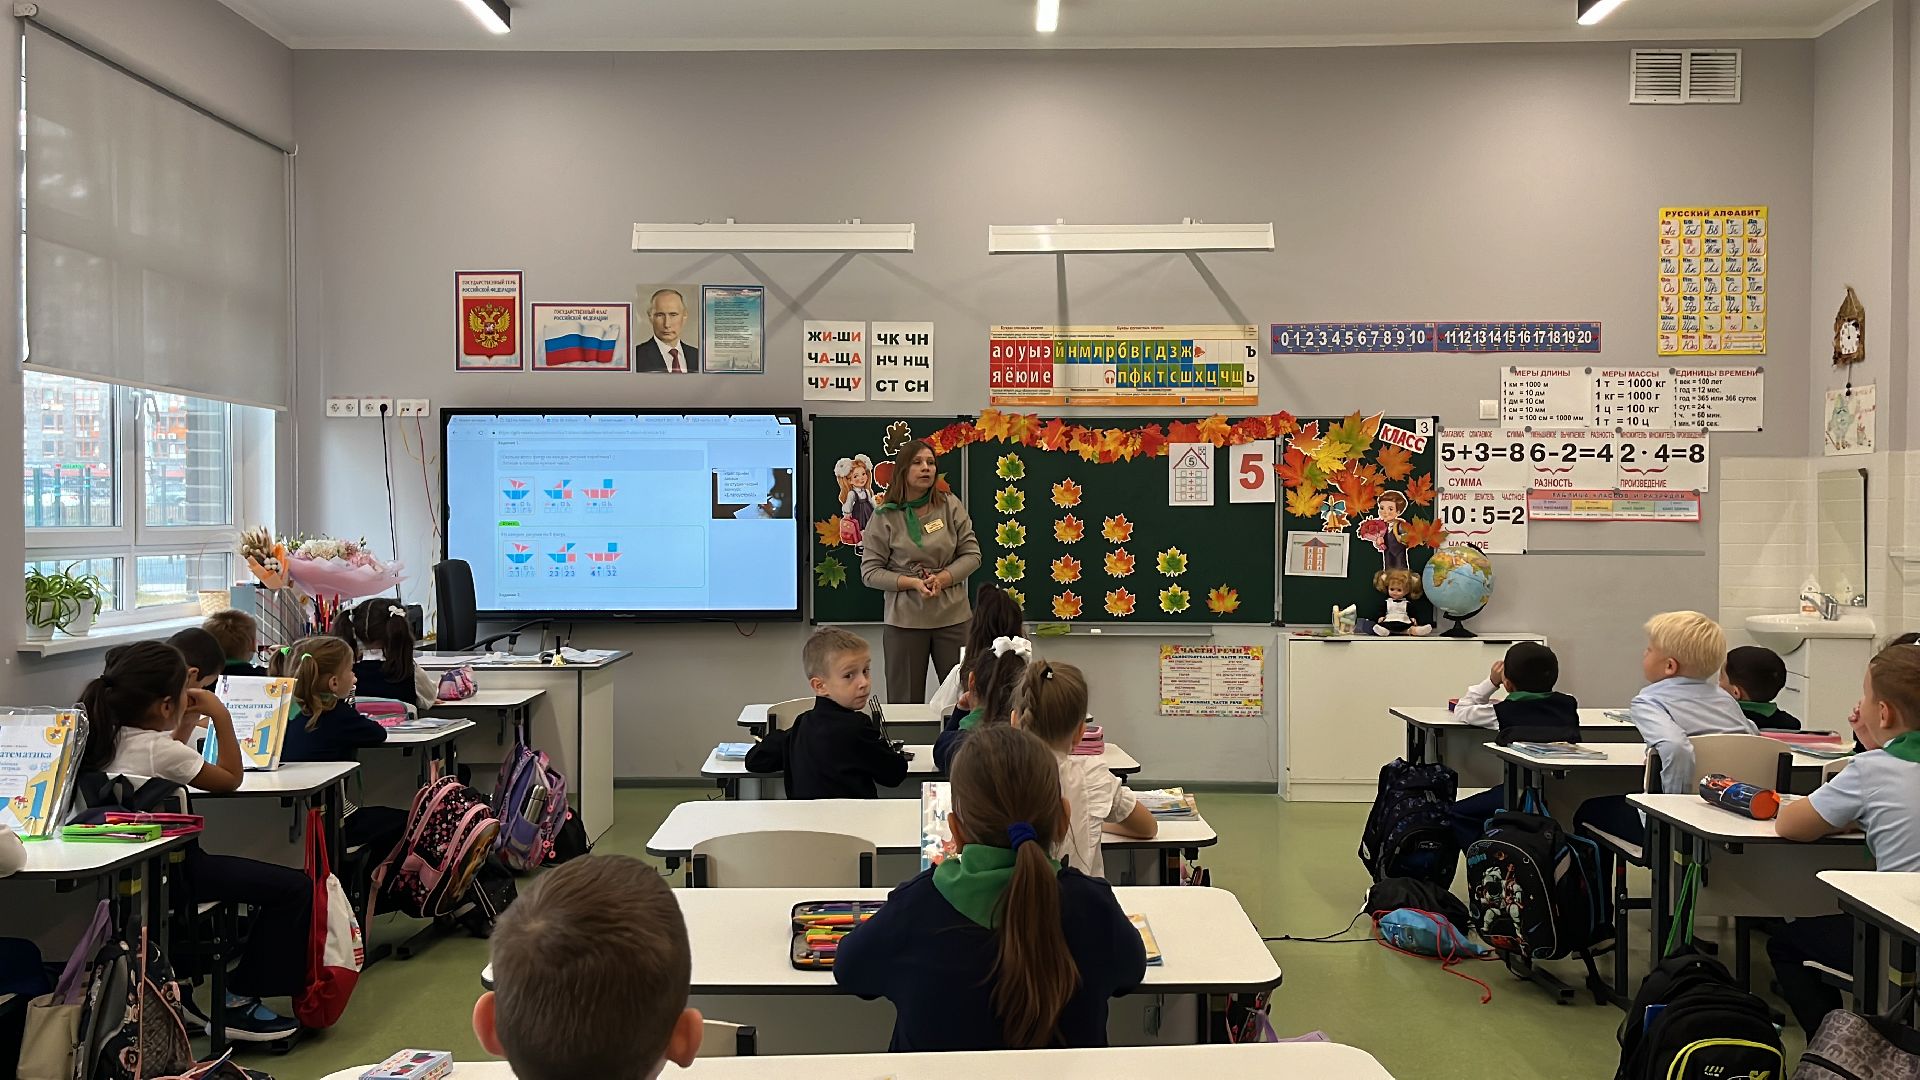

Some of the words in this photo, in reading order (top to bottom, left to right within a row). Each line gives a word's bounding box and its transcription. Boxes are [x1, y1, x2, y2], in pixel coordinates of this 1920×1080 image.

[808, 331, 861, 342] ЖИ-ШИ
[877, 334, 899, 345] ЧК
[906, 334, 928, 345] ЧН
[1281, 332, 1289, 346] 0
[1294, 332, 1300, 345] 1
[1306, 332, 1314, 345] 2
[1319, 332, 1327, 345] 3
[1332, 331, 1340, 345] 4
[1345, 331, 1353, 345] 5
[1358, 331, 1366, 344] 6
[1371, 331, 1378, 344] 7
[1383, 331, 1391, 344] 8
[1396, 331, 1405, 344] 9
[1409, 330, 1425, 344] 10
[1445, 331, 1456, 343] 11
[1458, 331, 1471, 343] 12
[1473, 331, 1486, 343] 13
[1488, 331, 1501, 343] 14
[1503, 331, 1516, 343] 15
[1518, 331, 1530, 343] 16
[1533, 331, 1546, 343] 17
[1547, 331, 1560, 343] 18
[1563, 331, 1575, 343] 19
[1578, 331, 1591, 343] 20
[808, 352, 861, 365] ЧА-ЩА
[877, 356, 897, 366] НЧ
[904, 356, 929, 368] НЩ
[808, 377, 861, 391] ЧУ-ЩУ
[876, 380, 898, 392] СТ
[905, 380, 928, 392] СН
[1596, 379, 1600, 387] 1
[1628, 379, 1652, 387] 1000
[1596, 392, 1600, 400] 1
[1628, 392, 1651, 400] 1000
[1605, 406, 1610, 414] ц
[1421, 422, 1428, 433] 3
[1595, 417, 1599, 425] 1
[1627, 417, 1638, 425] 10
[1642, 419, 1649, 427] ц
[1381, 426, 1425, 451] КЛАСС
[1441, 443, 1524, 462] 5+3=8
[1530, 443, 1613, 462] 6-2=4
[1188, 458, 1195, 466] 5
[1240, 453, 1264, 490] 5
[1534, 479, 1572, 487] РАЗНОСТЬ
[1620, 480, 1666, 488] ПРОИЗВЕДЕНИЕ
[1441, 493, 1466, 501] ДЕЛИМОЕ
[254, 725, 271, 755] 1
[27, 780, 48, 820] 1
